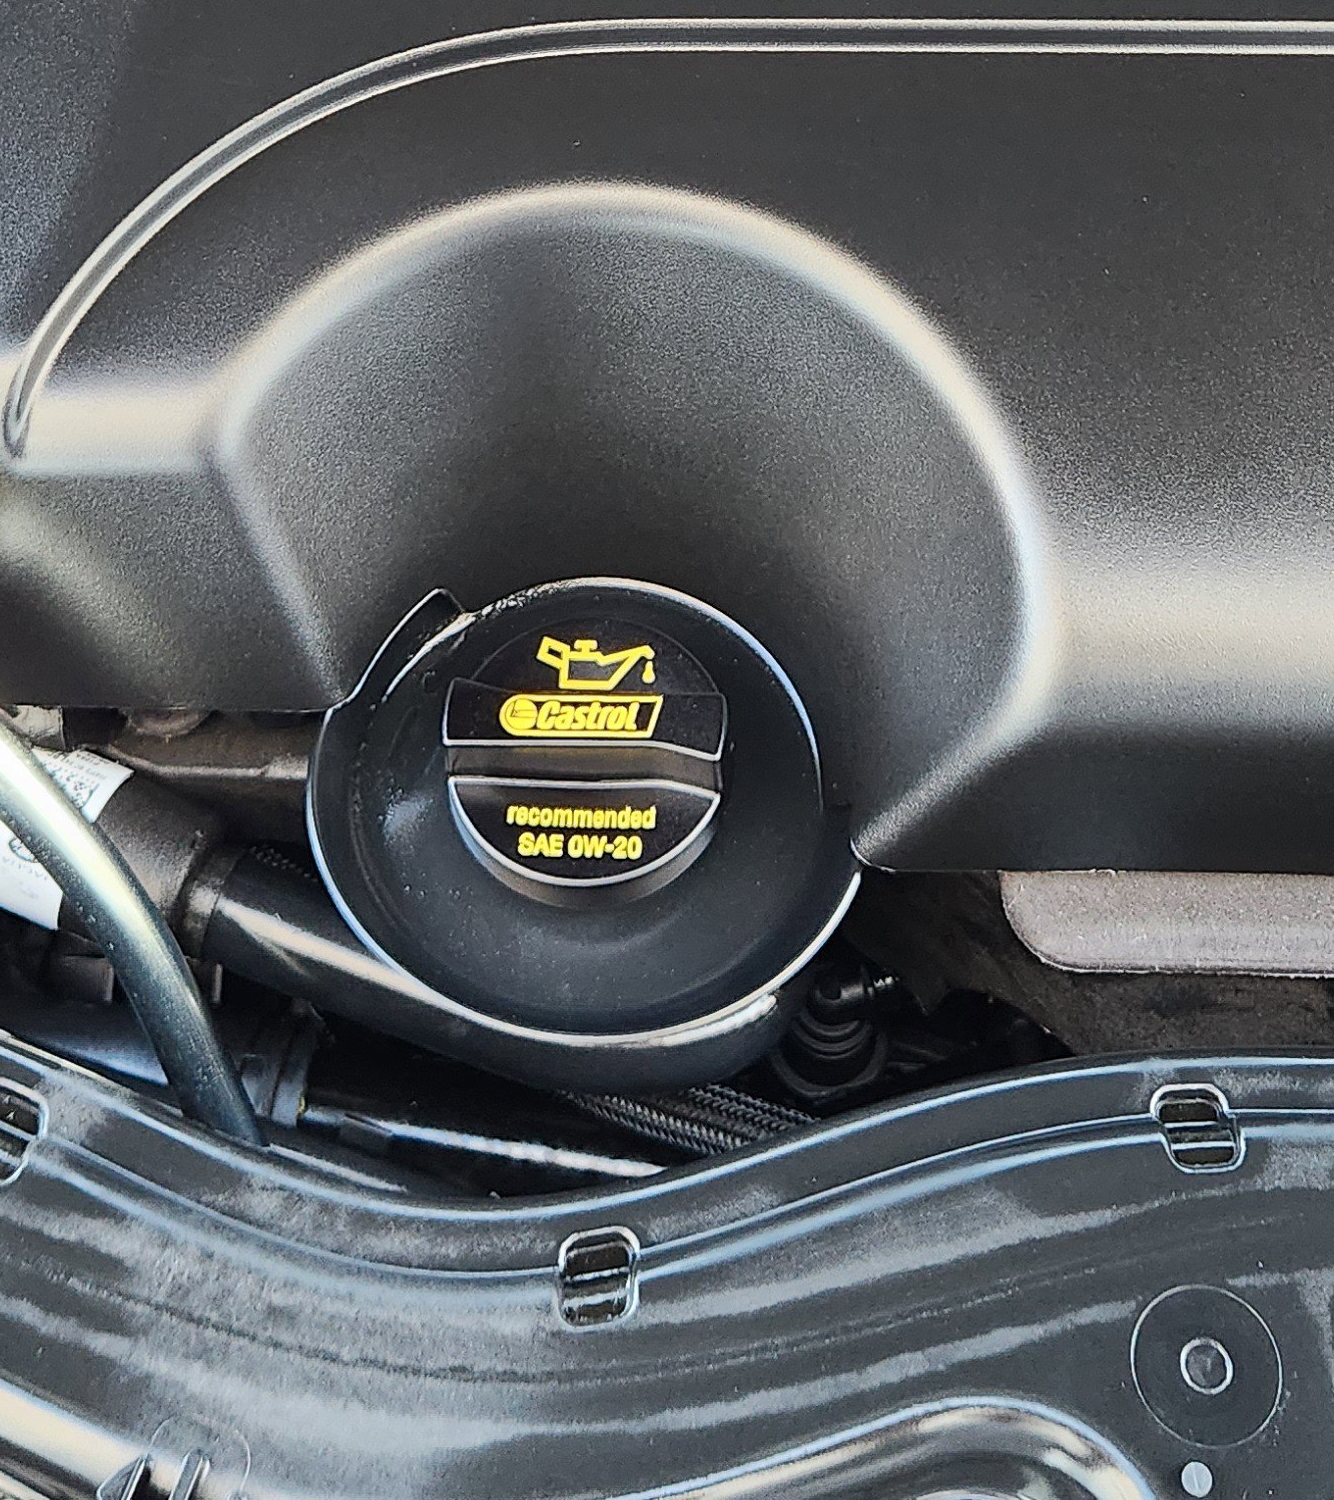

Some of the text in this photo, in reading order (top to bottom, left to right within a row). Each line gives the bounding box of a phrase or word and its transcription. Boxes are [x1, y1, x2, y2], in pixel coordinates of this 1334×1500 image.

[535, 700, 641, 731] Castrol
[505, 804, 657, 830] recommended
[517, 831, 643, 860] SAE 0W-20
